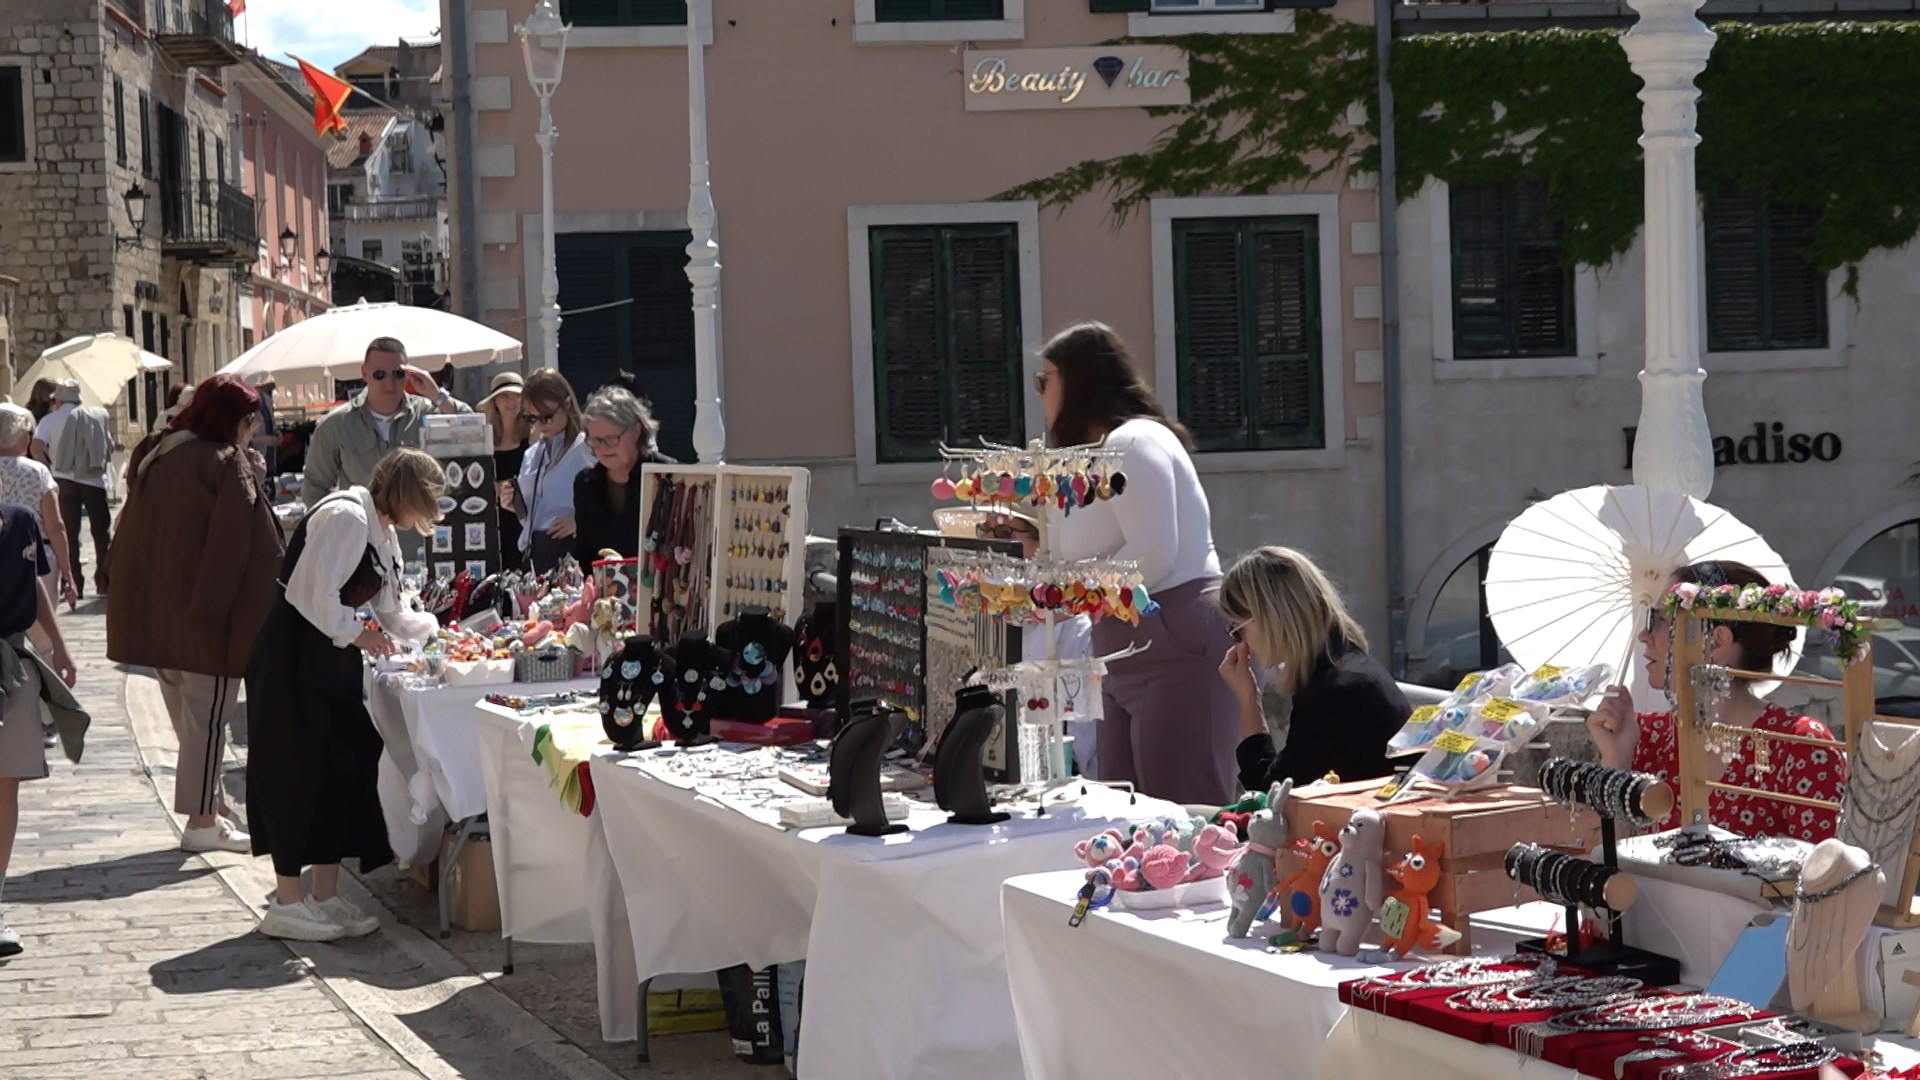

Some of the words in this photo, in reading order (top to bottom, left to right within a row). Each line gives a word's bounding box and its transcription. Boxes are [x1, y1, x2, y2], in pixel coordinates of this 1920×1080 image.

[969, 57, 1088, 103] Beauty
[1128, 56, 1182, 88] bar
[1623, 422, 1842, 469] adiso
[756, 1021, 770, 1047] La
